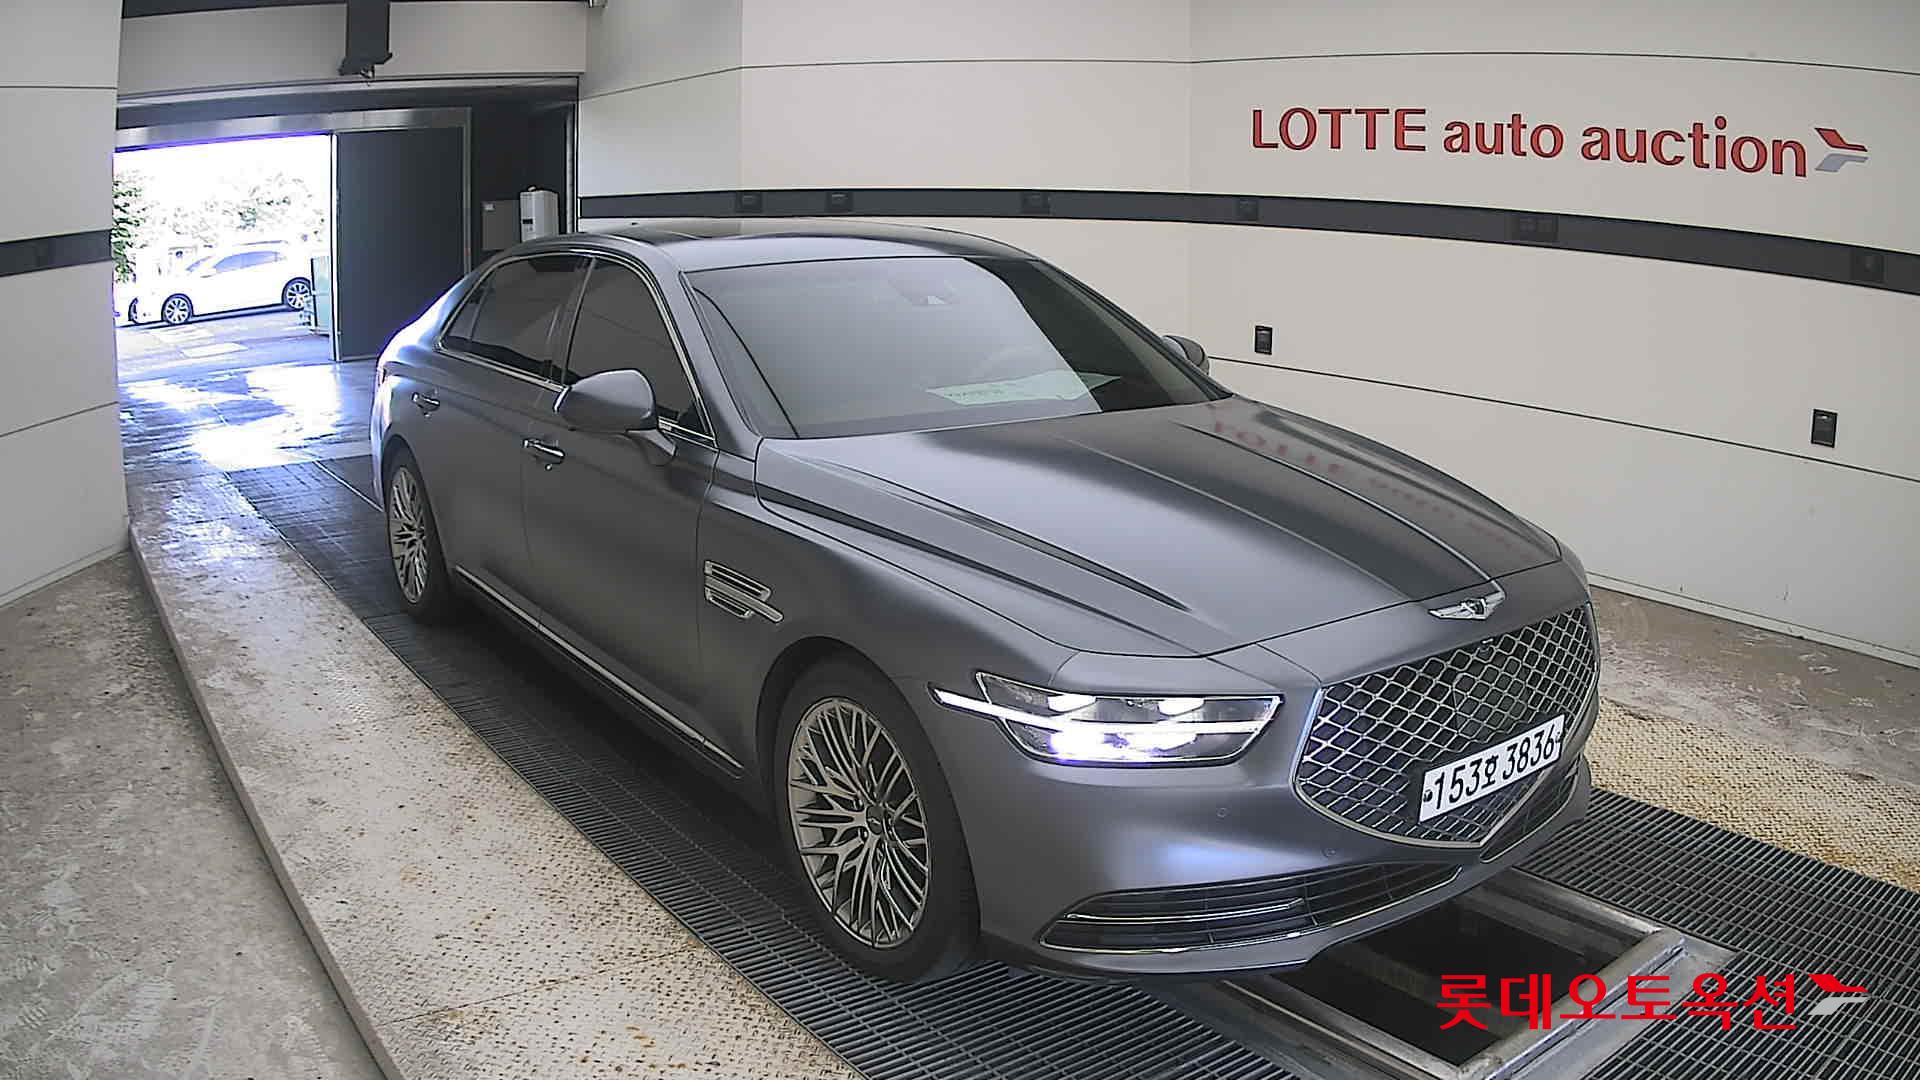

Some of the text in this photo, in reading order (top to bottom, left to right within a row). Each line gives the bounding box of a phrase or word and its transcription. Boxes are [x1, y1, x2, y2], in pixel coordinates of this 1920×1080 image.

[1252, 107, 1808, 177] LOTTE auto auction
[1434, 723, 1556, 810] 153호 3836
